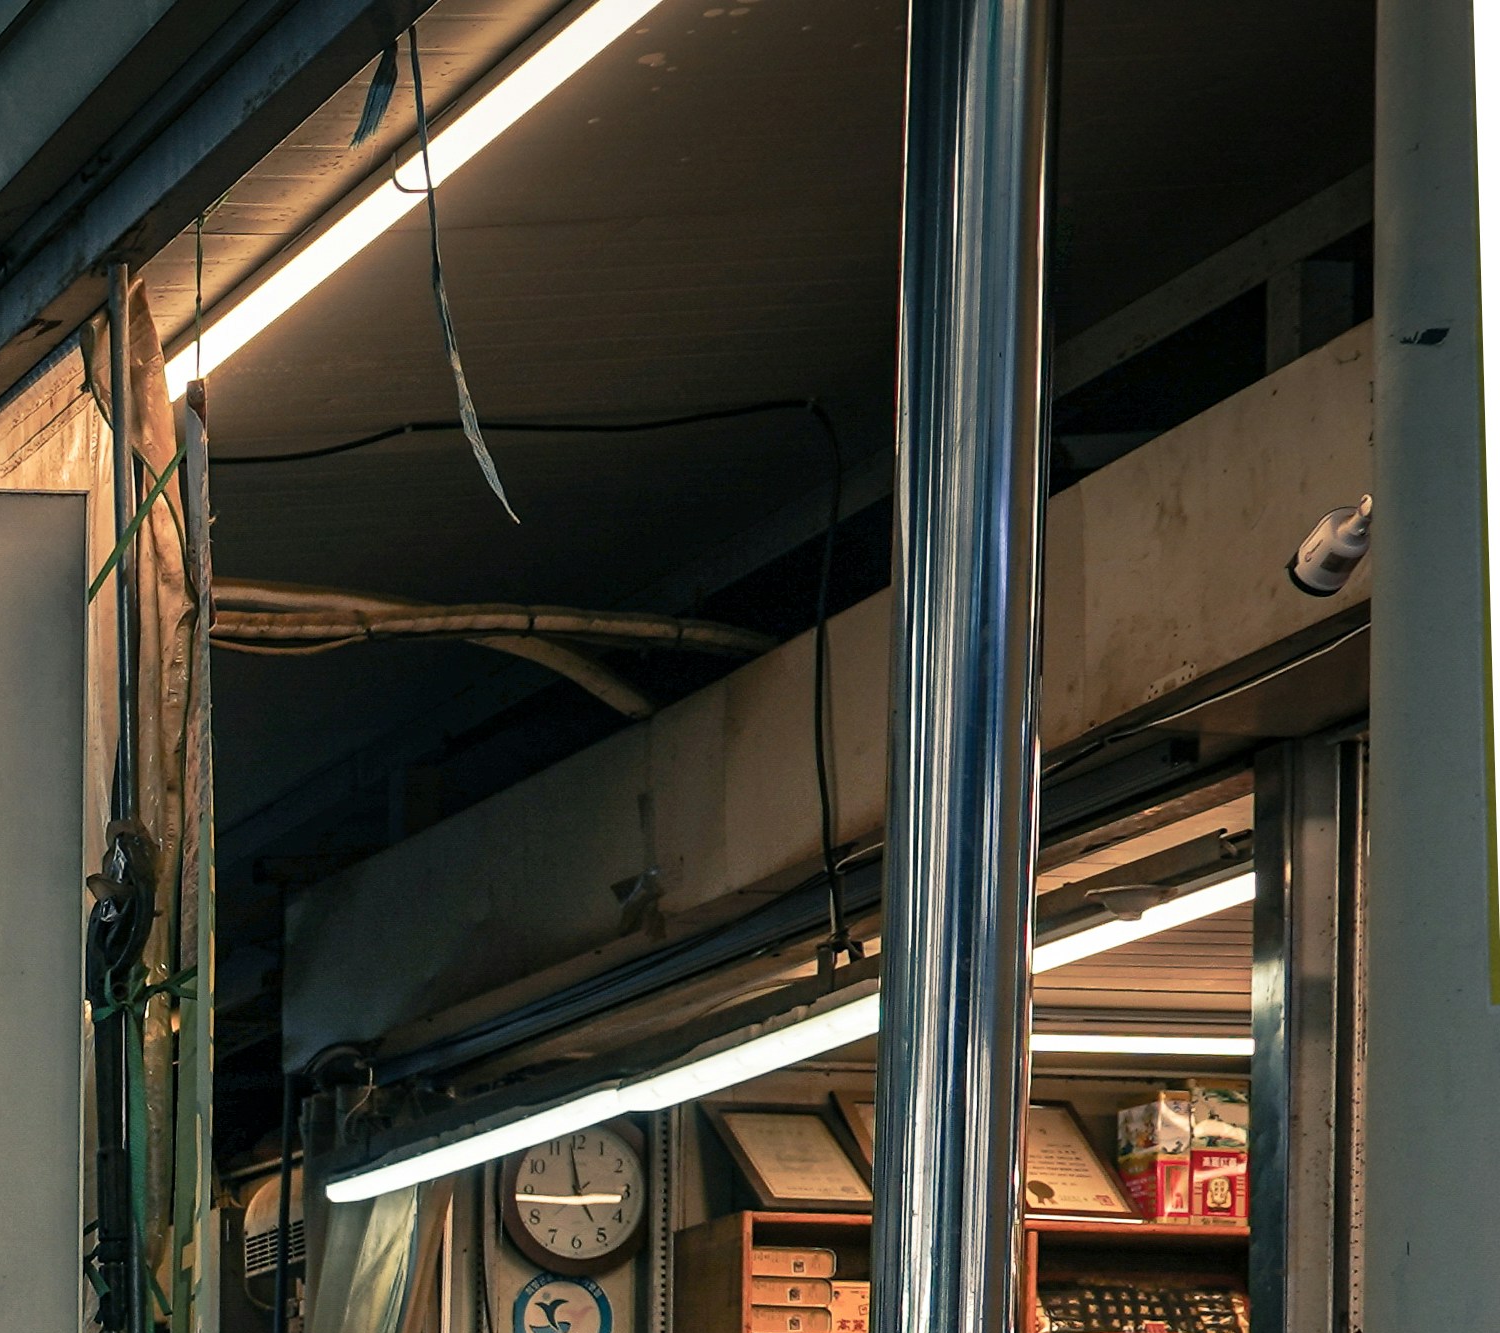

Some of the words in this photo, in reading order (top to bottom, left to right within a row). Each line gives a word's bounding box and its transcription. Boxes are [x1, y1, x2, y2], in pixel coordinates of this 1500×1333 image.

[549, 1140, 562, 1156] 11
[571, 1134, 587, 1151] 12
[599, 1141, 605, 1157] 1
[529, 1158, 546, 1174] 10
[614, 1158, 624, 1173] 2
[621, 1183, 631, 1200] 3
[529, 1208, 541, 1225] 8
[612, 1208, 624, 1224] 4
[547, 1228, 558, 1244] 7
[570, 1235, 582, 1250] 6
[596, 1227, 608, 1243] 5
